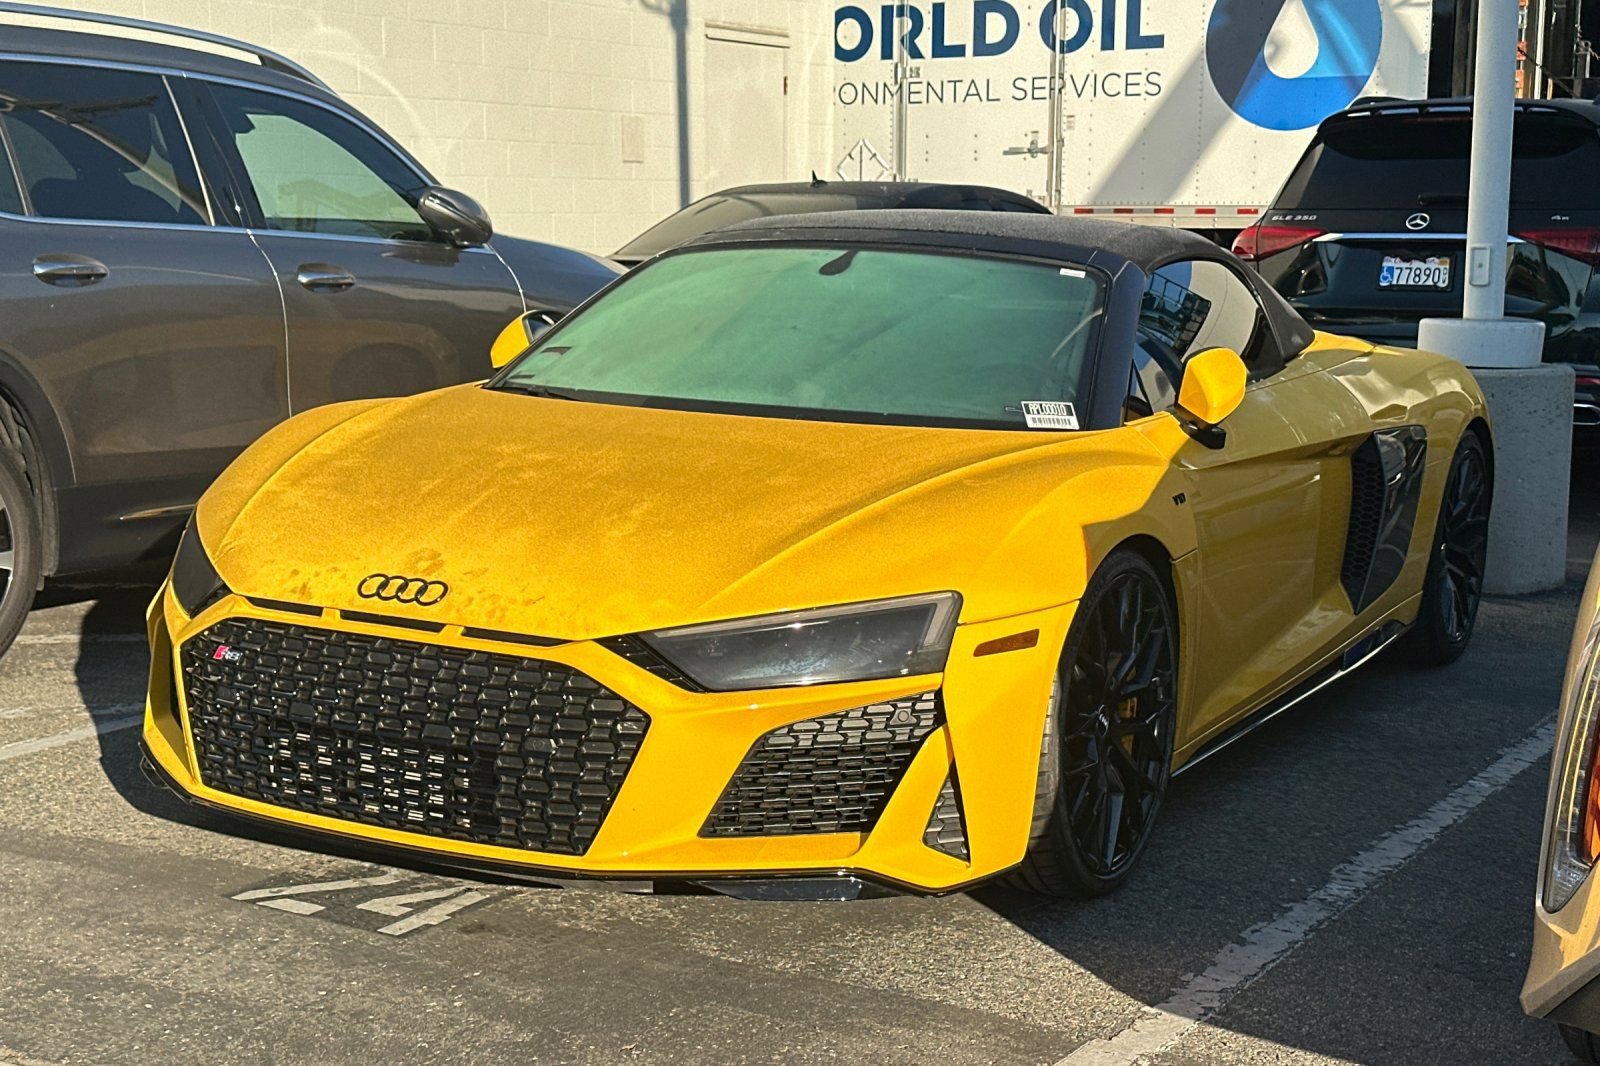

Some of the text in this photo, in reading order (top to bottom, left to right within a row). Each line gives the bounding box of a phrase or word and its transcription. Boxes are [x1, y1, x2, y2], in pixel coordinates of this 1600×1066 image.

[834, 0, 1165, 63] ORLD OIL
[835, 71, 1162, 106] ONMENTAL SERVICES
[1395, 266, 1441, 285] 77890
